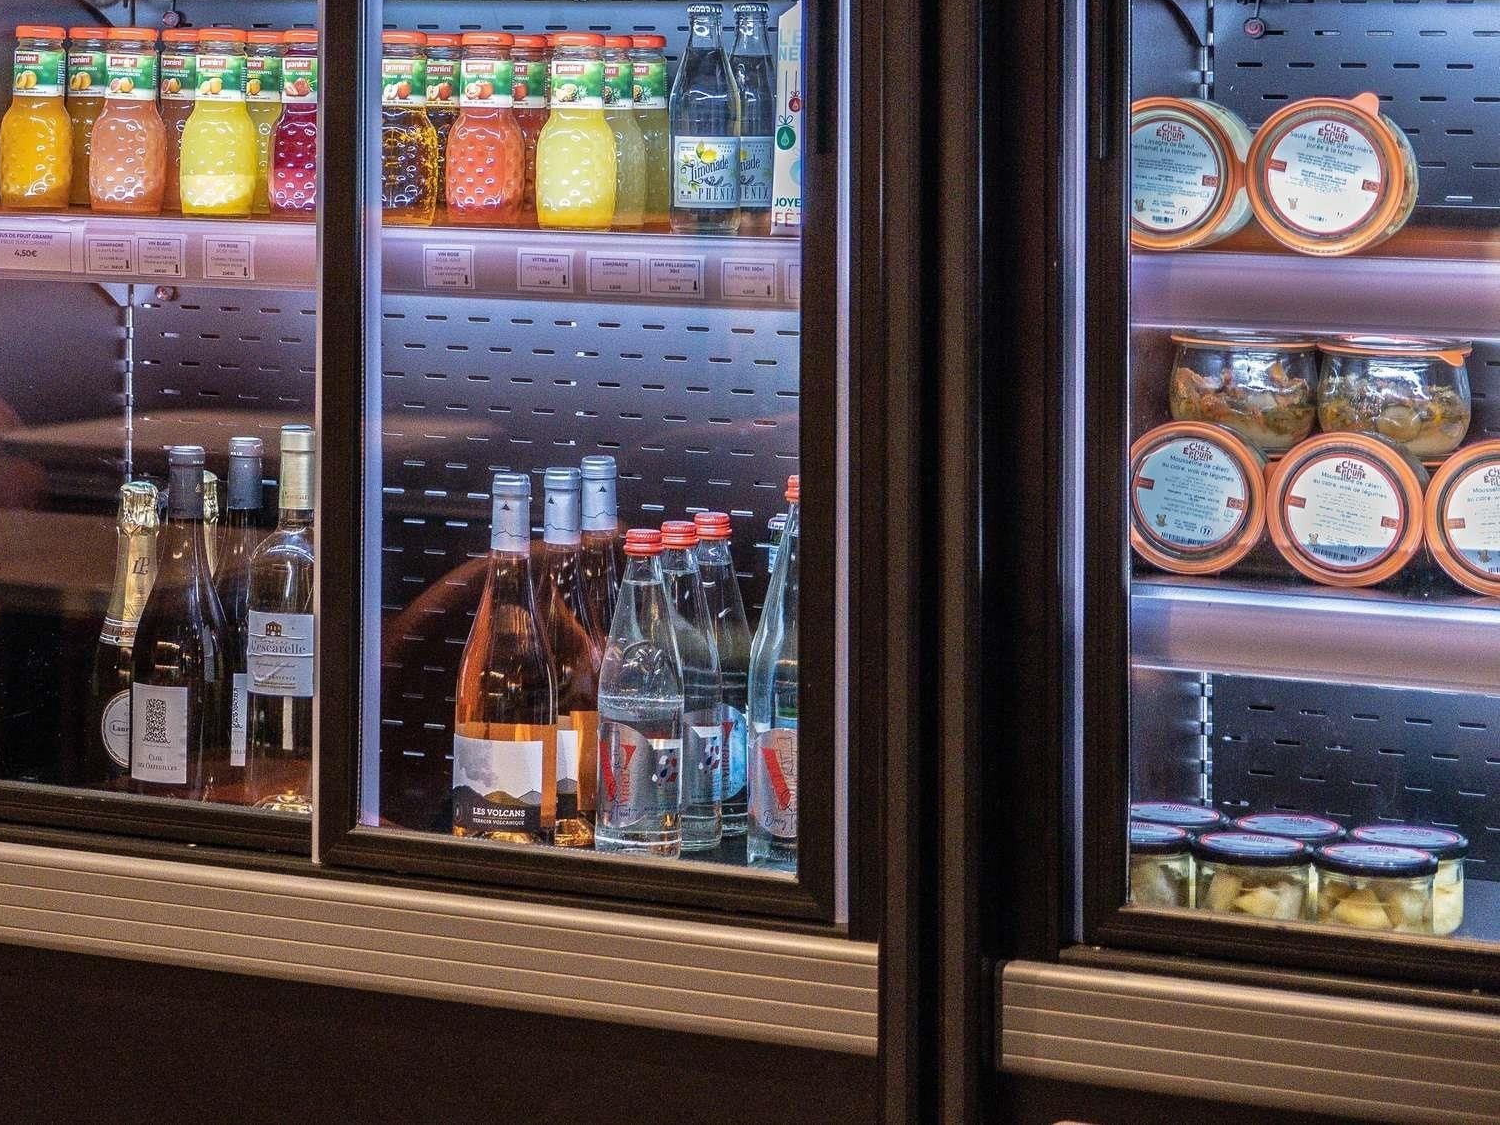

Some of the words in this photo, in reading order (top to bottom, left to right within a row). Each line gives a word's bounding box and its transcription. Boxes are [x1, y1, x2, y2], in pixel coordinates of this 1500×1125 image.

[1324, 123, 1348, 135] CHEZ
[681, 155, 729, 185] Limonade
[14, 248, 38, 258] 4,50€
[1188, 442, 1212, 454] CHEZ
[1341, 460, 1364, 471] CHEZ
[472, 807, 486, 815] LES
[486, 808, 526, 817] VOLCANS
